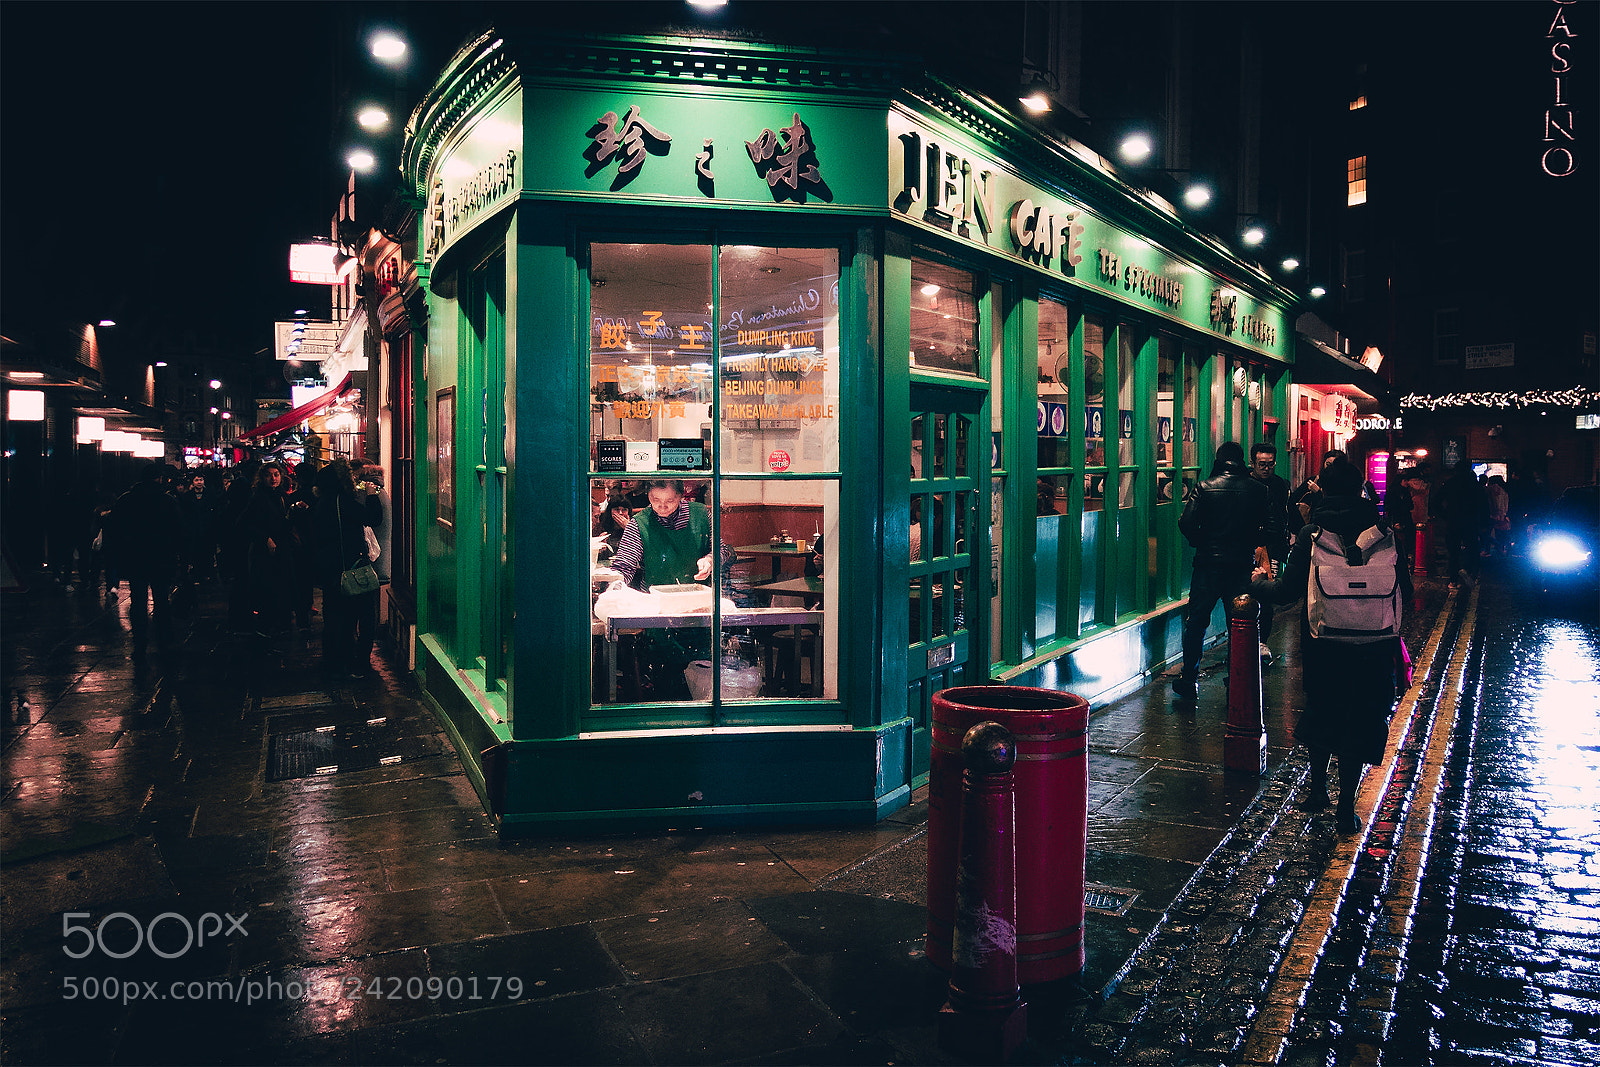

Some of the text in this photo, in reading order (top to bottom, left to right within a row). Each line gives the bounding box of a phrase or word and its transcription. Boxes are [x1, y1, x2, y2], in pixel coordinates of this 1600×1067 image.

[1542, 0, 1580, 177] ASINO
[894, 131, 995, 240] JEN
[1100, 249, 1185, 306] TEA SPECIALIST
[737, 330, 816, 346] DUMPLING KING
[726, 357, 769, 372] FRESHLY
[770, 357, 799, 372] HAND
[724, 380, 824, 396] BEIJING DUMPLINGS
[726, 404, 834, 419] TAKEAWAY AVAILABLE
